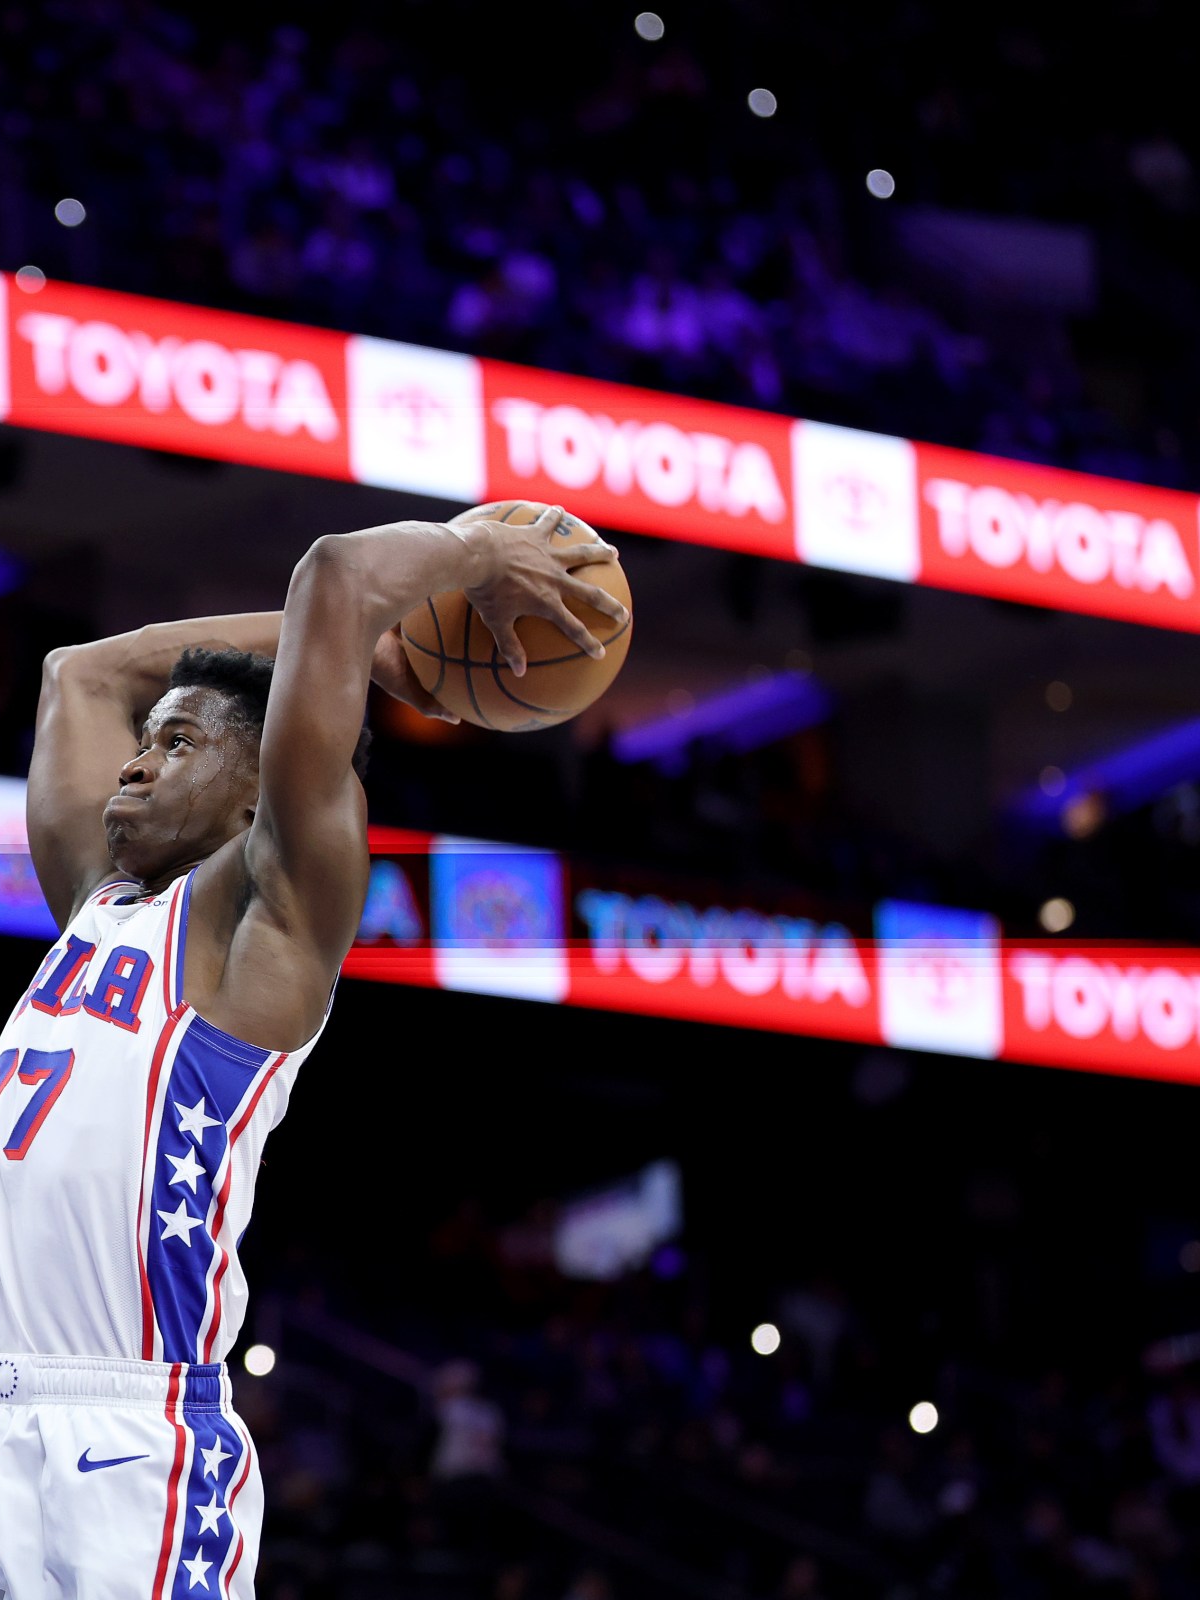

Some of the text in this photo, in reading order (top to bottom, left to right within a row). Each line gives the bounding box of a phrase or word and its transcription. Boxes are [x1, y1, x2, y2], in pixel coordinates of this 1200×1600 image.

[18, 313, 338, 442] TOYOTA
[493, 398, 785, 522] TOYOTA
[924, 478, 1193, 598] TOYOTA
[575, 888, 871, 1007] TOYOTA
[1008, 949, 1200, 1050] TOYO
